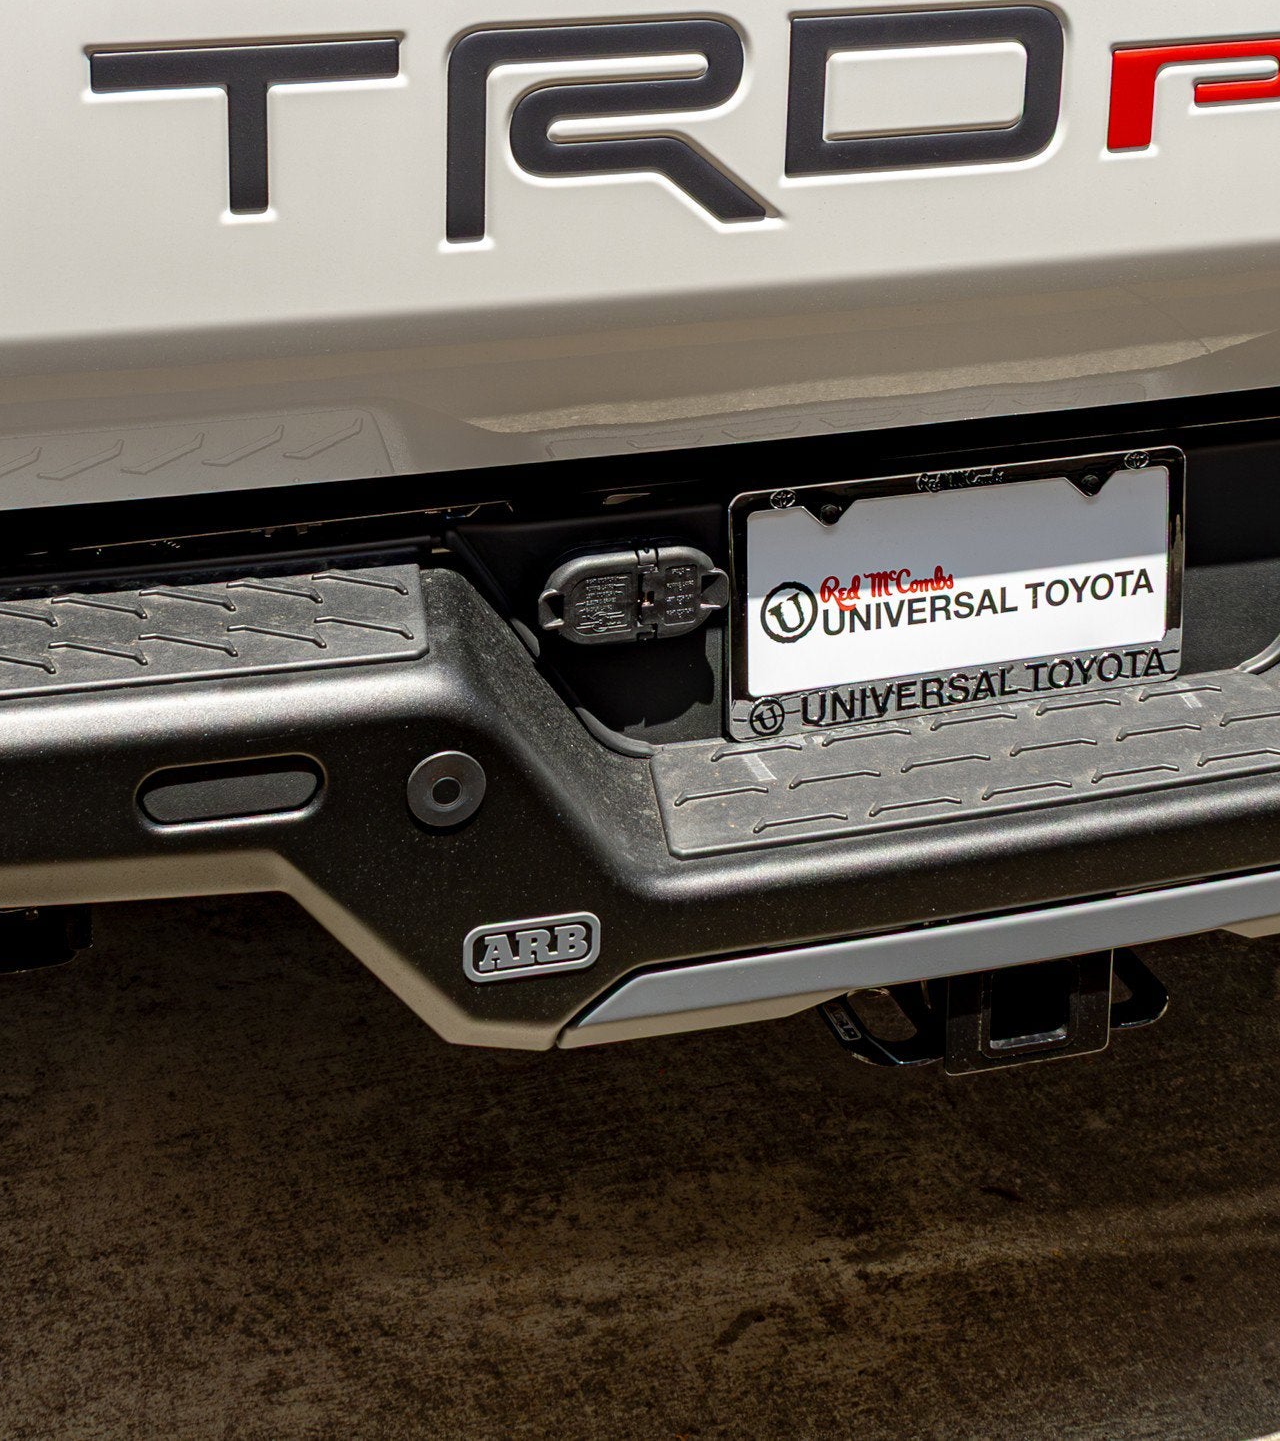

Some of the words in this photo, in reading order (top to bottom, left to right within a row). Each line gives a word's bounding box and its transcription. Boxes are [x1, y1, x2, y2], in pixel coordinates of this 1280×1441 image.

[89, 5, 1063, 245] TRD
[821, 575, 861, 611] Red
[863, 565, 954, 599] McCombs
[822, 587, 1018, 636] UNIVERSAL
[1024, 568, 1154, 609] TOYOTA
[801, 665, 1018, 726] UNIVERSAL
[1024, 647, 1166, 691] TOYOTA
[478, 924, 588, 971] ARB
